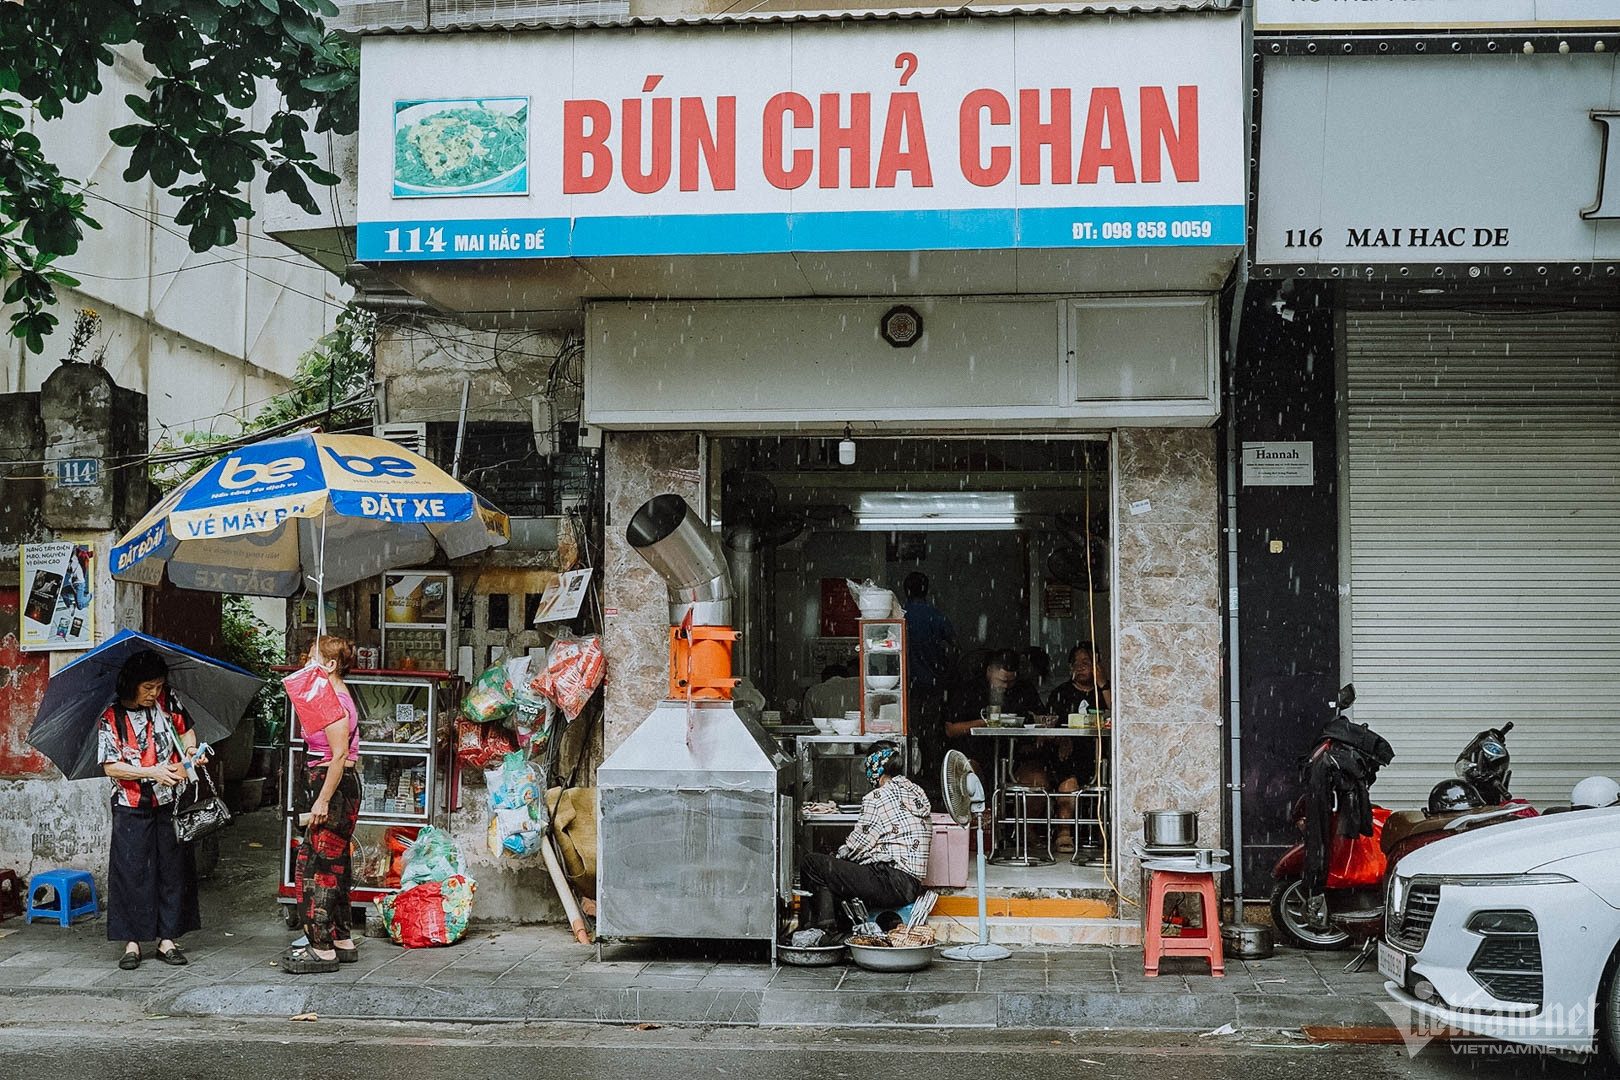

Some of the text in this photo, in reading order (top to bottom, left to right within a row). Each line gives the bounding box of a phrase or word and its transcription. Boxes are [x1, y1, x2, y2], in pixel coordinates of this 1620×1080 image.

[563, 52, 1200, 194] BÚN CHẢ CHAN
[384, 227, 546, 253] 114 MAI HẮC ĐẾ
[1072, 221, 1212, 239] ĐT: 098 858 0059
[1284, 227, 1510, 248] 116 MAI HAC DE
[322, 446, 417, 477] be
[1256, 449, 1300, 459] Hannah
[64, 462, 91, 482] 114
[219, 457, 306, 489] be
[360, 494, 446, 522] ĐẶT XE
[188, 513, 216, 537] VÉ
[222, 507, 268, 533] MÁY
[518, 704, 539, 715] POCA
